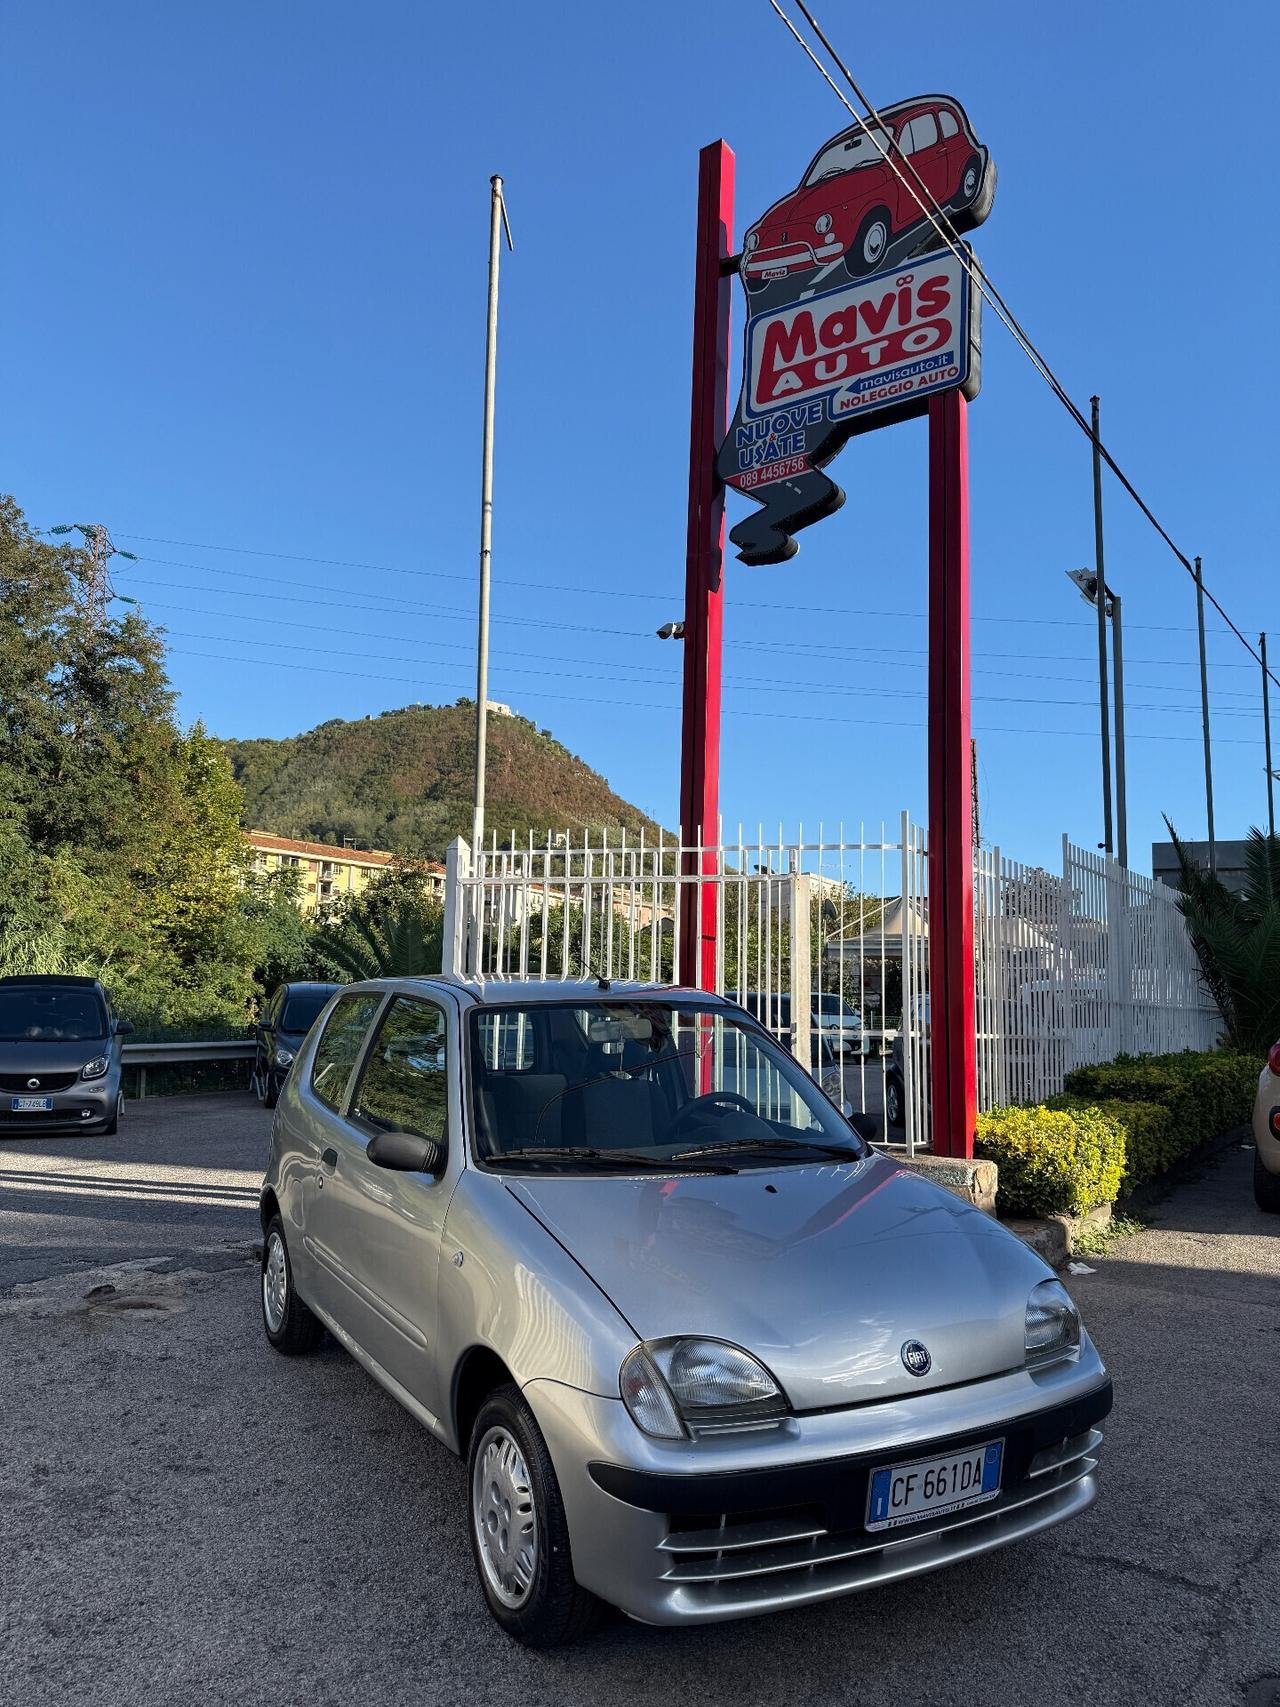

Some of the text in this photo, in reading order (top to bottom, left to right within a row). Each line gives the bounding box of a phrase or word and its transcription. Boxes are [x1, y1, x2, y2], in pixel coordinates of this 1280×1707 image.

[772, 326, 940, 396] AUTO
[860, 354, 949, 390] mavisauto.it
[840, 366, 959, 410] NOLEGGIO AUTO
[736, 401, 823, 448] NUOVE
[739, 430, 806, 470] USATE
[740, 457, 804, 488] 089 4456756
[908, 1350, 927, 1365] FIAT
[891, 1473, 918, 1508] CF
[923, 1456, 982, 1499] 661DA
